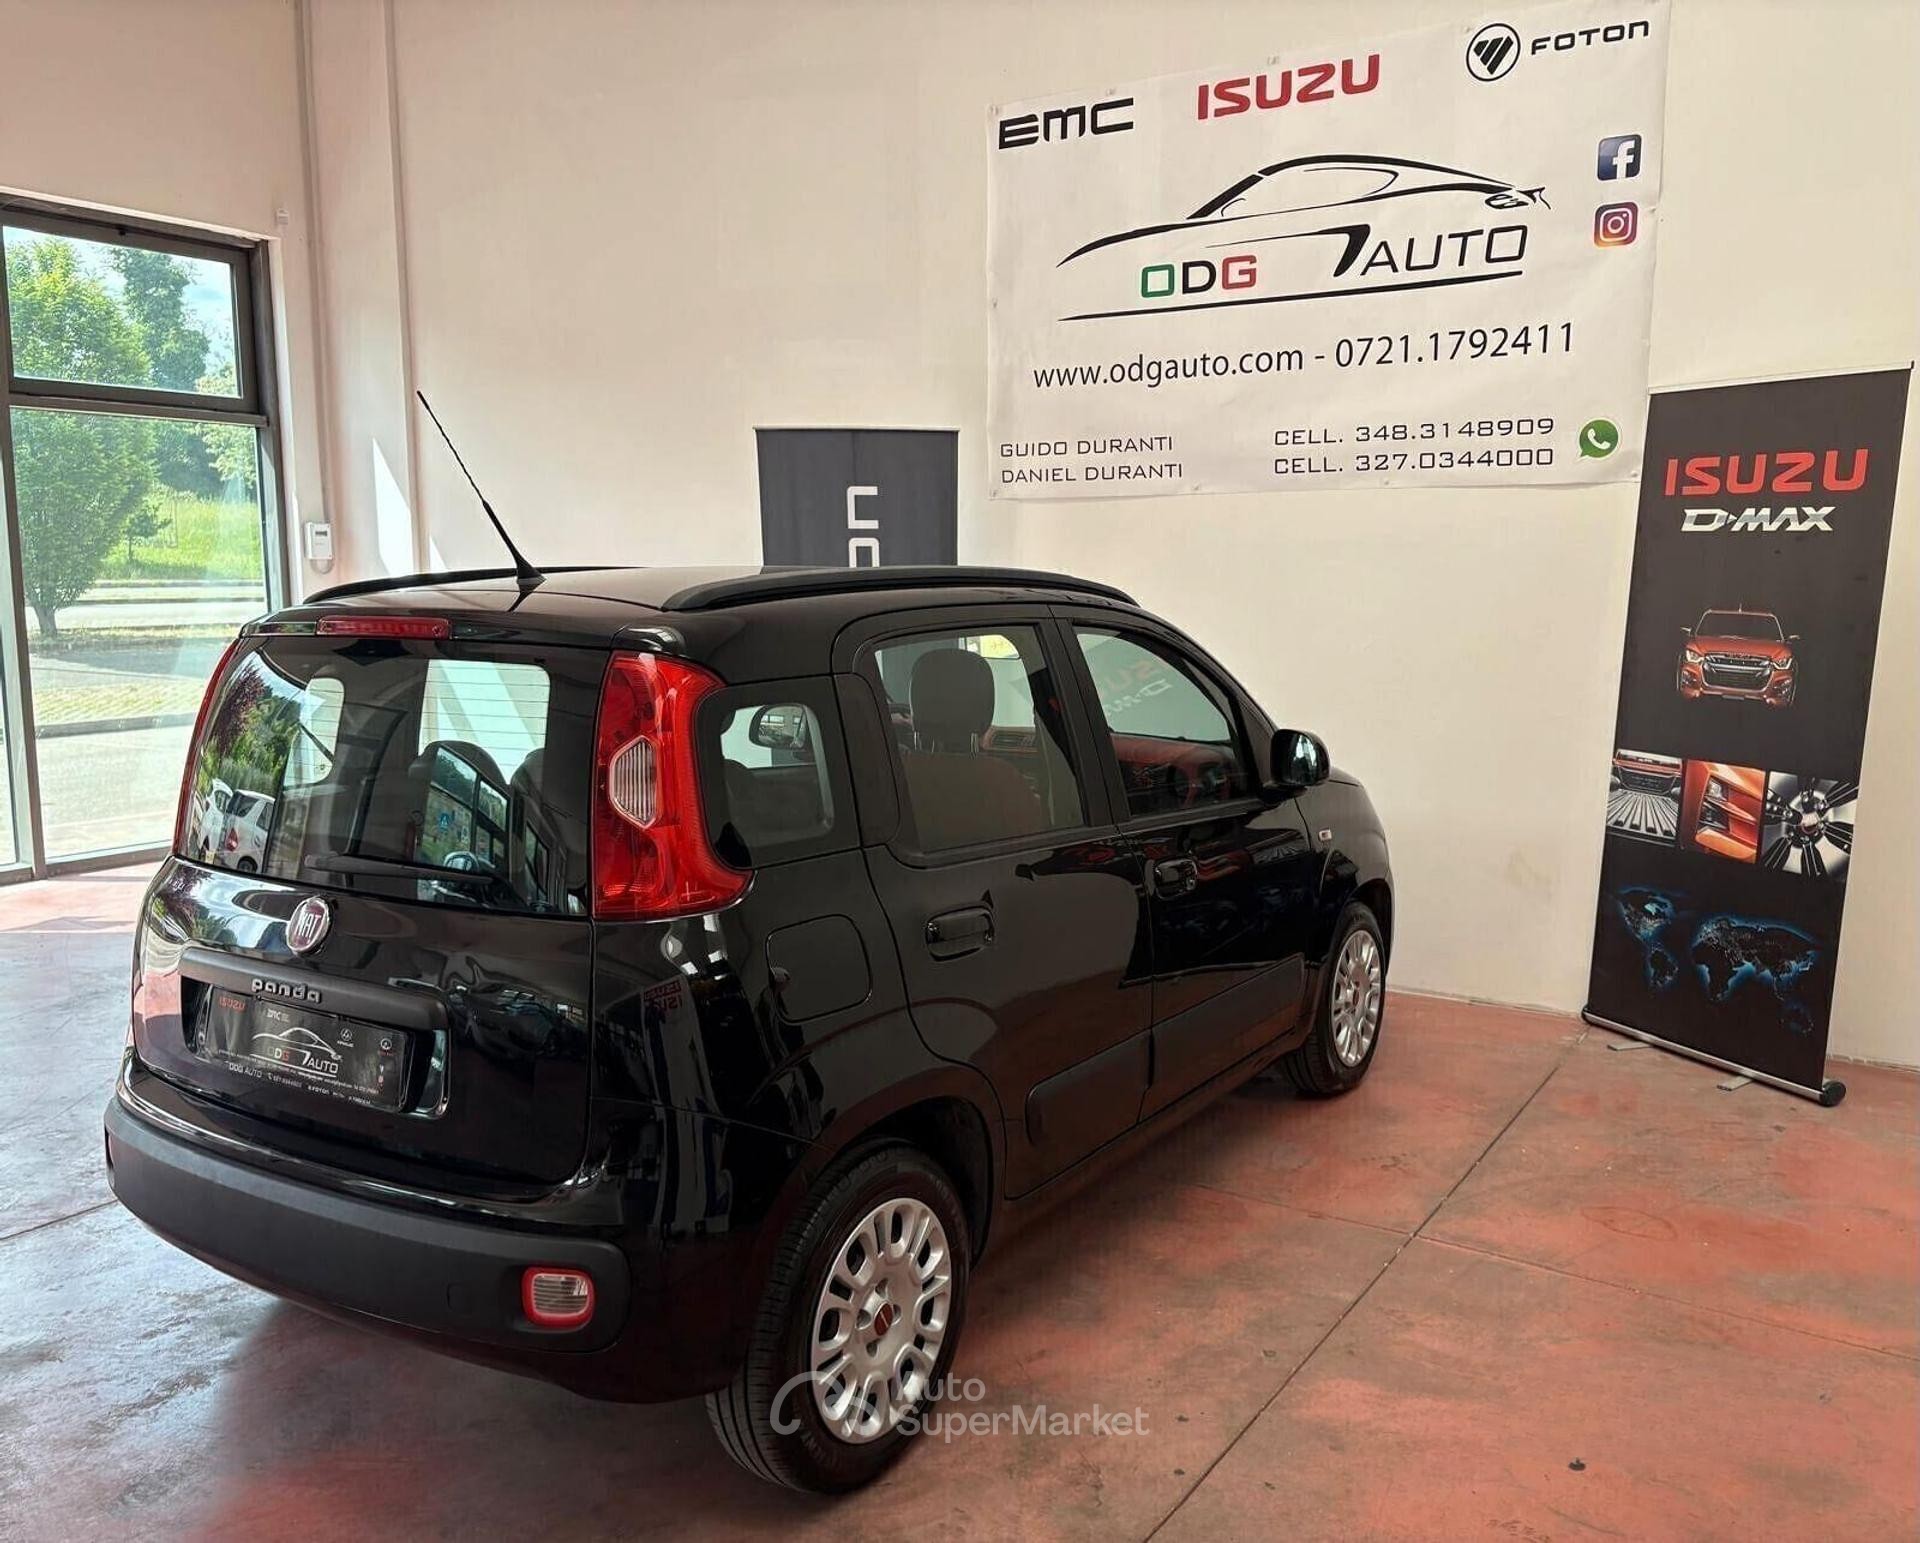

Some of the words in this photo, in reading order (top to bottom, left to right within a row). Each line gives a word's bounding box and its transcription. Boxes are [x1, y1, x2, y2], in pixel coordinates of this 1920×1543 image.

[1530, 20, 1650, 56] FOTON
[1198, 54, 1380, 120] ISUZU
[998, 97, 1134, 149] EMC
[1141, 255, 1257, 299] ODG
[1360, 224, 1529, 276] AUTO
[1033, 343, 1304, 389] www.odgauto.com
[1335, 322, 1573, 368] 0721.1792411
[1273, 427, 1344, 446] CELL.
[1355, 417, 1555, 444] 348.3148909
[1000, 440, 1069, 459] GUIDO
[1077, 436, 1174, 456] DURANTI
[1273, 455, 1344, 475] CELL.
[1355, 447, 1555, 473] 327.0344000
[1001, 465, 1077, 484] DANIEL
[1085, 462, 1184, 481] DURANTI
[1664, 448, 1869, 496] ISUZU
[1681, 506, 1837, 532] D-MAX
[251, 977, 322, 1003] panda
[308, 1058, 339, 1075] AUTO
